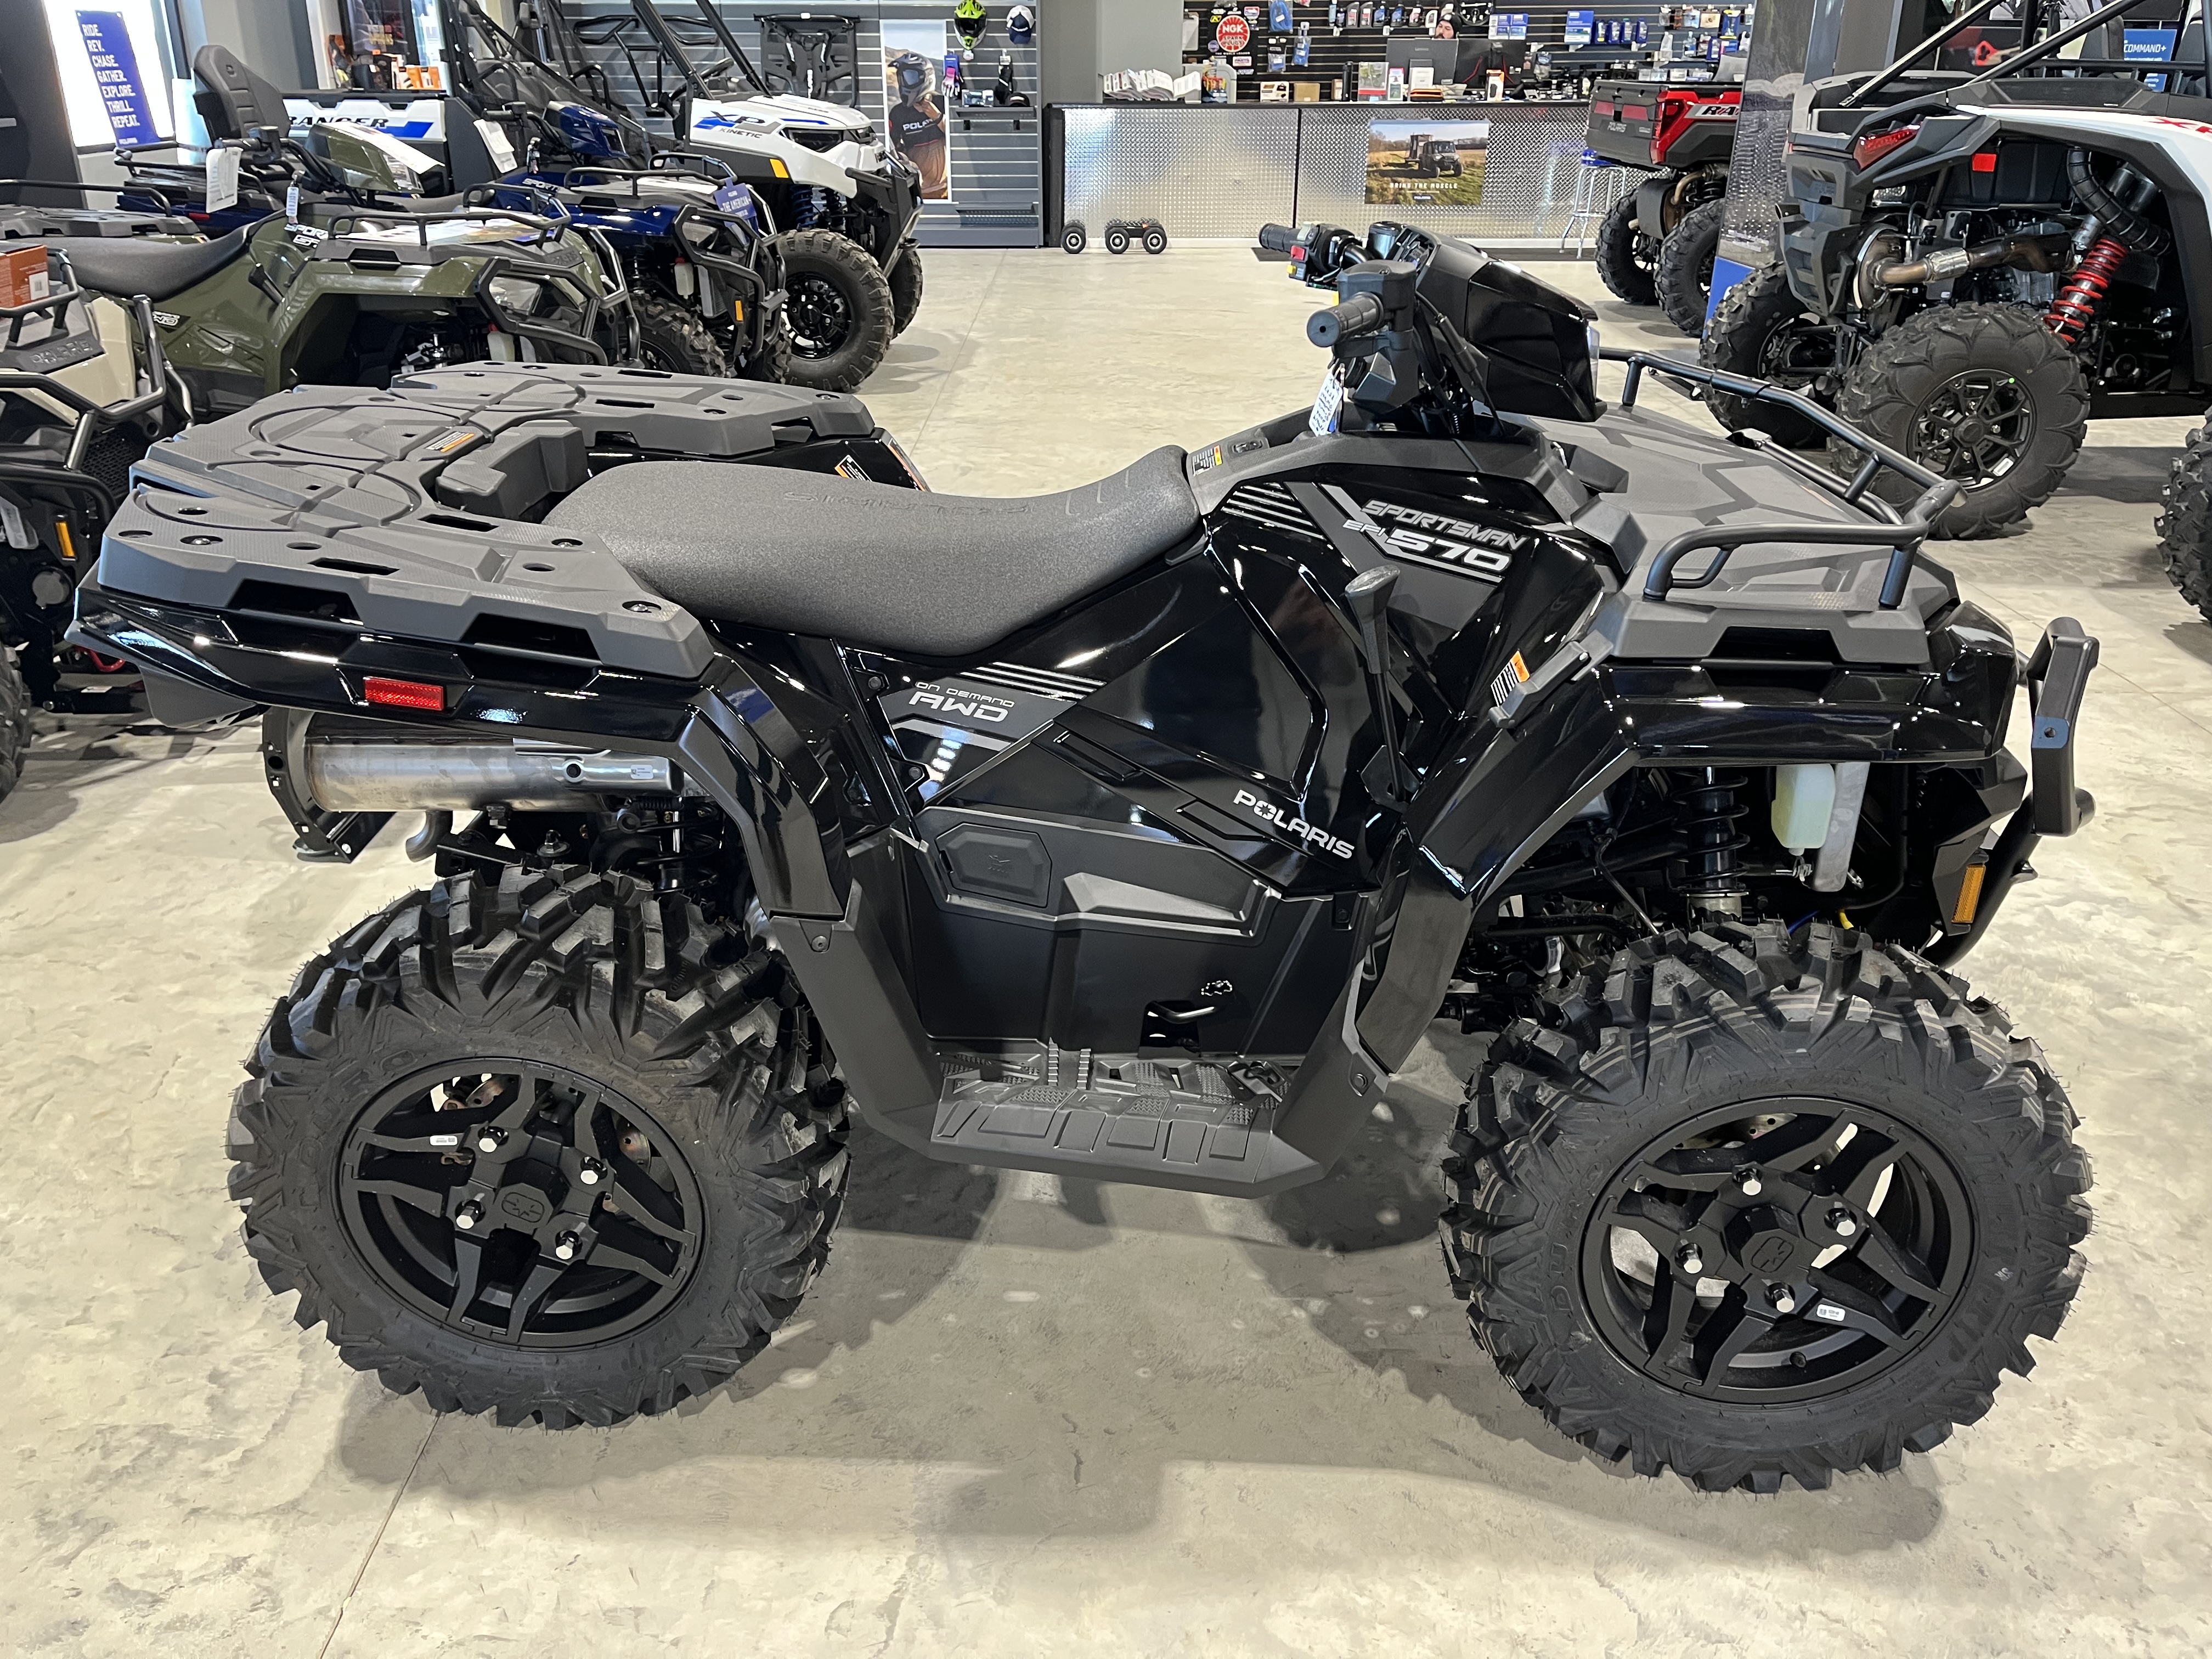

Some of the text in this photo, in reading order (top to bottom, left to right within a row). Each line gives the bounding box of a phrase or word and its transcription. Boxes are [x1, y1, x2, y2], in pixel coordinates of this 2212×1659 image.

[82, 24, 103, 36] RIDE.
[1222, 24, 1244, 33] NGK
[86, 40, 105, 52] REV.
[2124, 44, 2166, 53] COMMAND+
[92, 55, 119, 67] CHASE.
[97, 70, 127, 83] GATHER.
[101, 84, 136, 98] EXPLORE.
[106, 100, 134, 113] THRILL.
[111, 115, 140, 128] REPEAT.
[719, 128, 763, 138] KINETIC
[1360, 499, 1530, 551] SPORTSMAN
[1342, 519, 1510, 572] EFI 570
[916, 681, 1015, 708] ON DEMAND
[909, 691, 1008, 723] AWD
[1233, 789, 1355, 859] POLARIS
